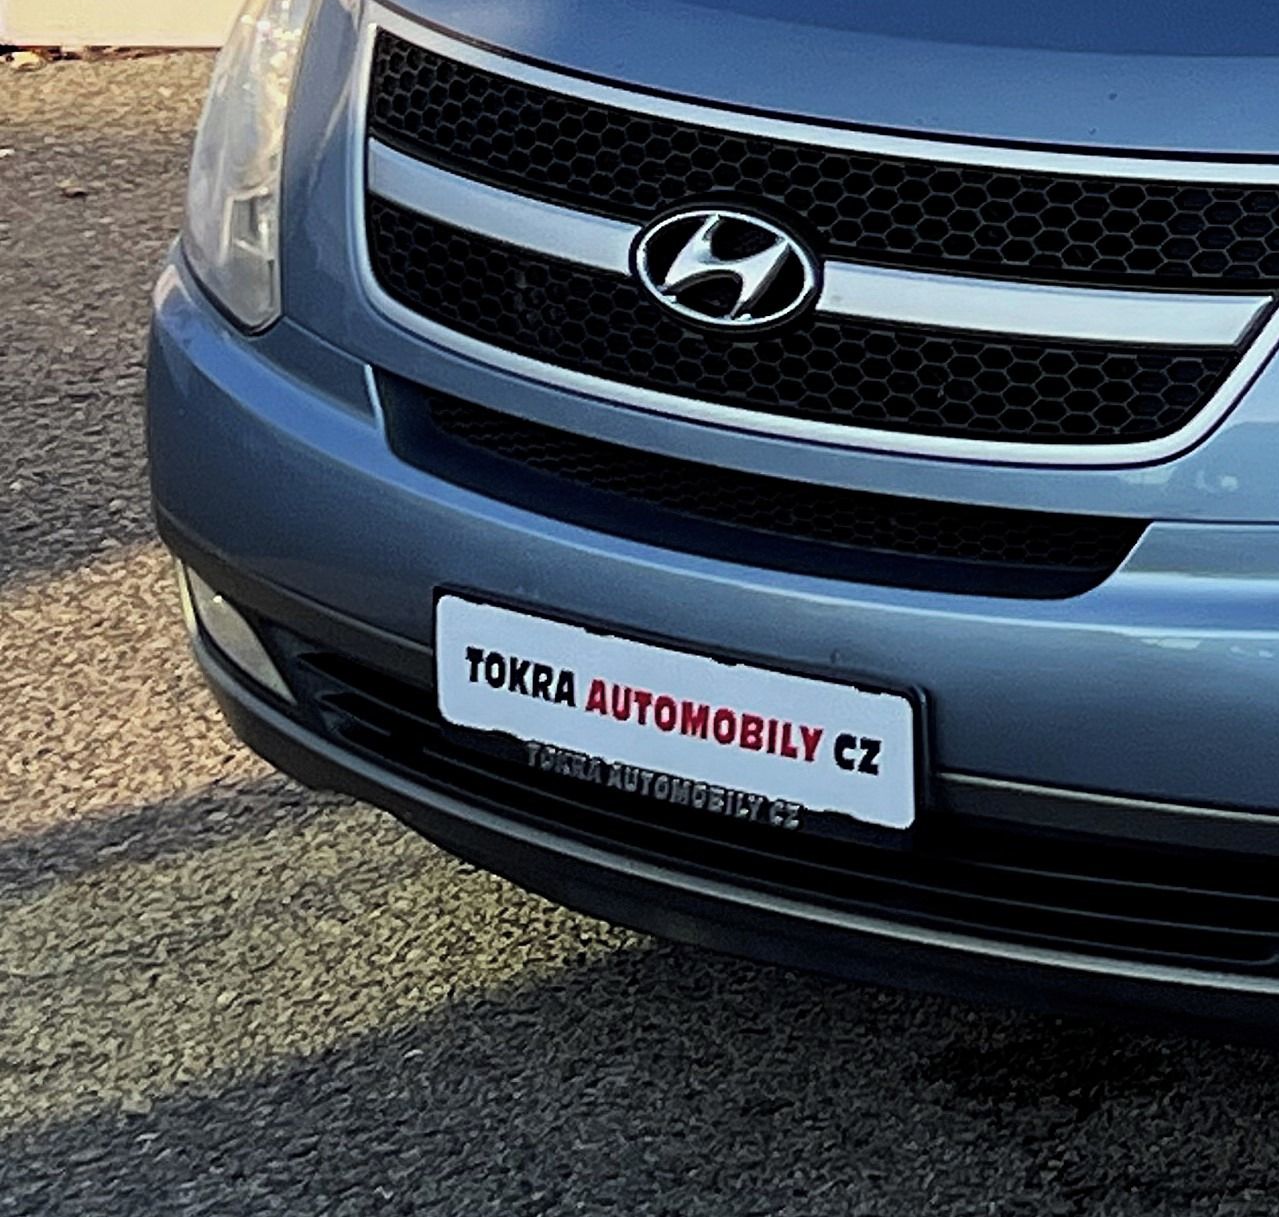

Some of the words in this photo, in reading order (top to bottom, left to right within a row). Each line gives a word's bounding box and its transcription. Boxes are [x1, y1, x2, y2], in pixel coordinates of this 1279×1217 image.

[466, 645, 577, 708] TOKRA
[585, 678, 824, 762] AUTOMOBILY
[833, 733, 883, 775] CZ
